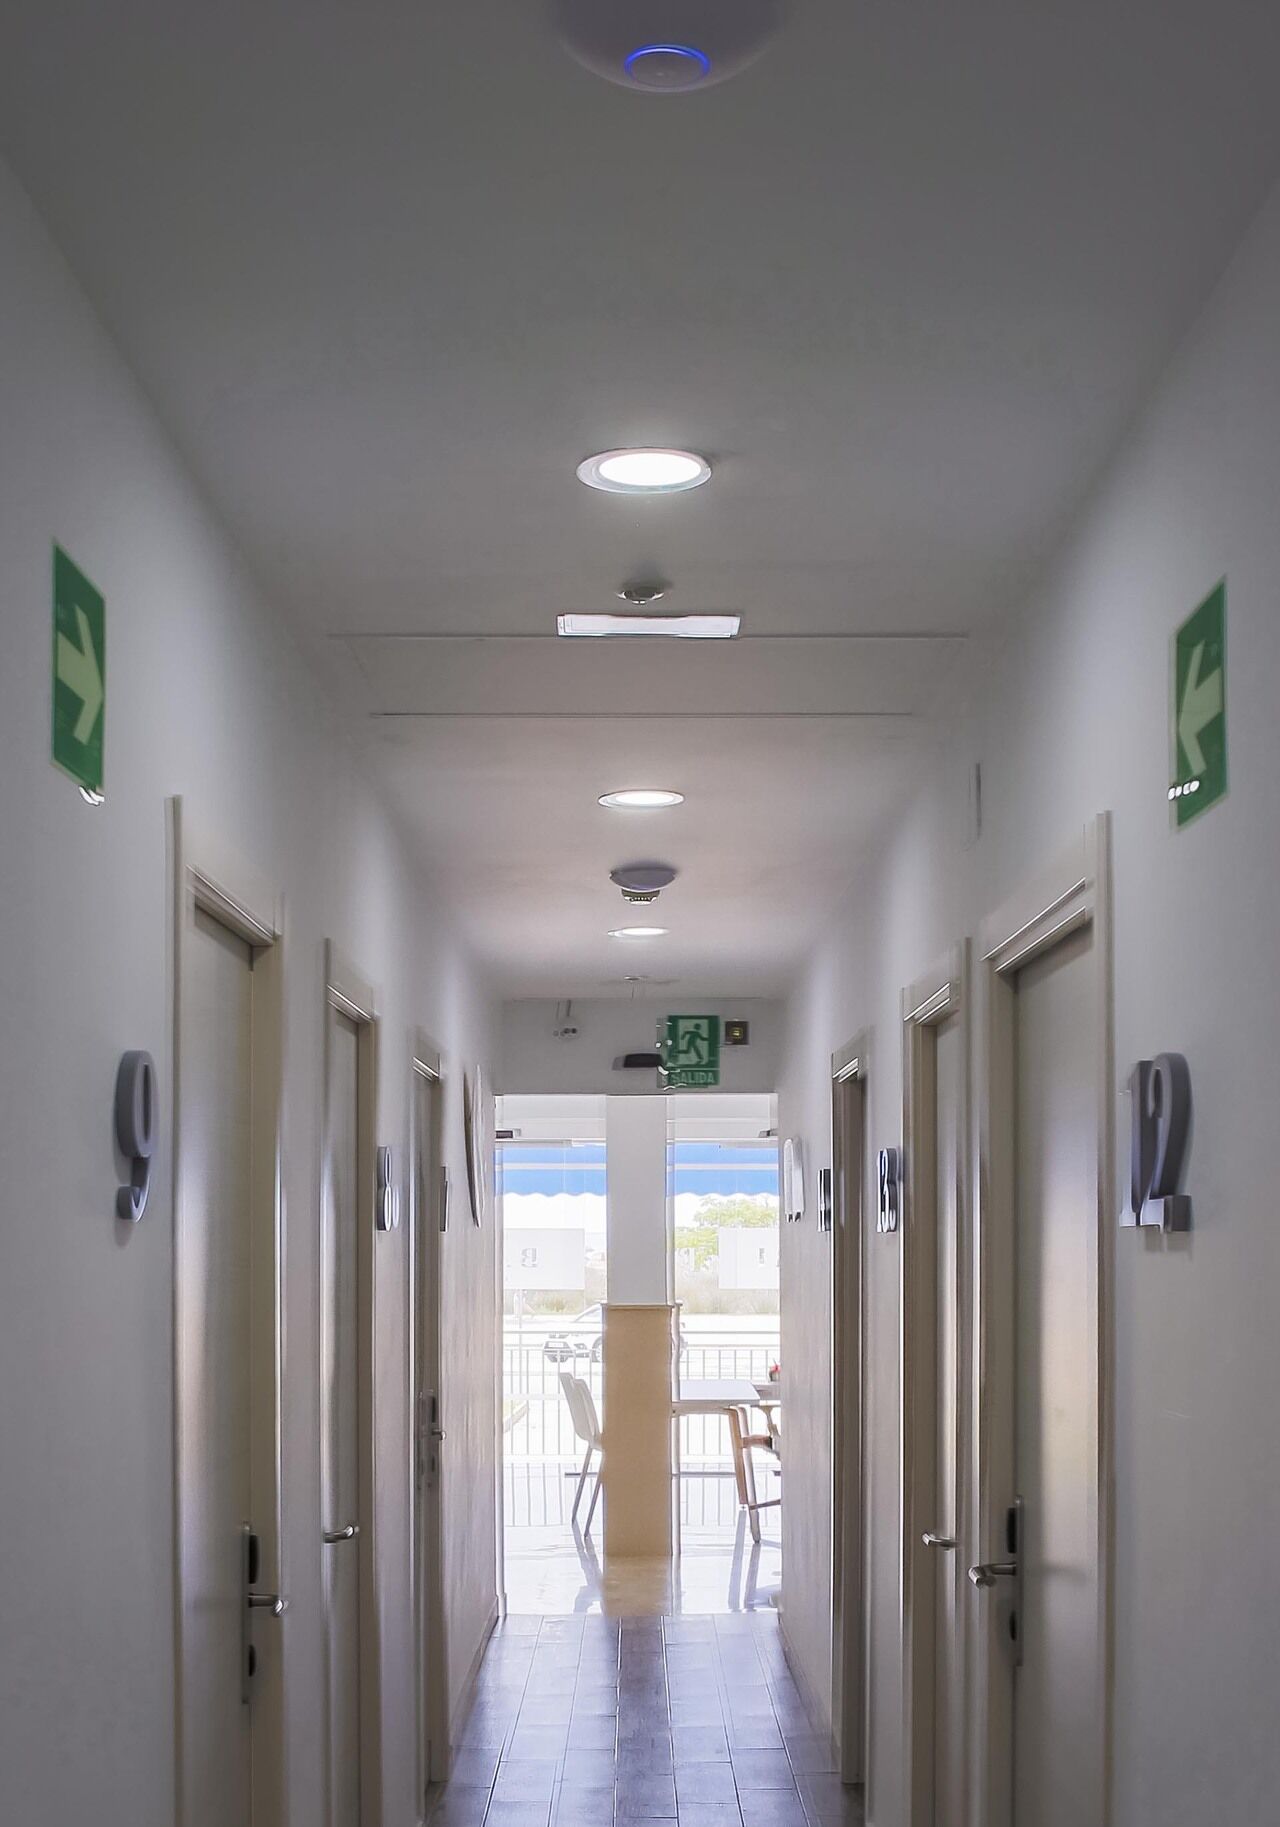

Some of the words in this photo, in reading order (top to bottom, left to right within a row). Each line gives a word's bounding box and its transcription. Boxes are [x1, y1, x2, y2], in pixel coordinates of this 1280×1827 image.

[116, 1050, 159, 1222] 9
[671, 1071, 715, 1085] SALIDA
[1119, 1052, 1193, 1231] 12
